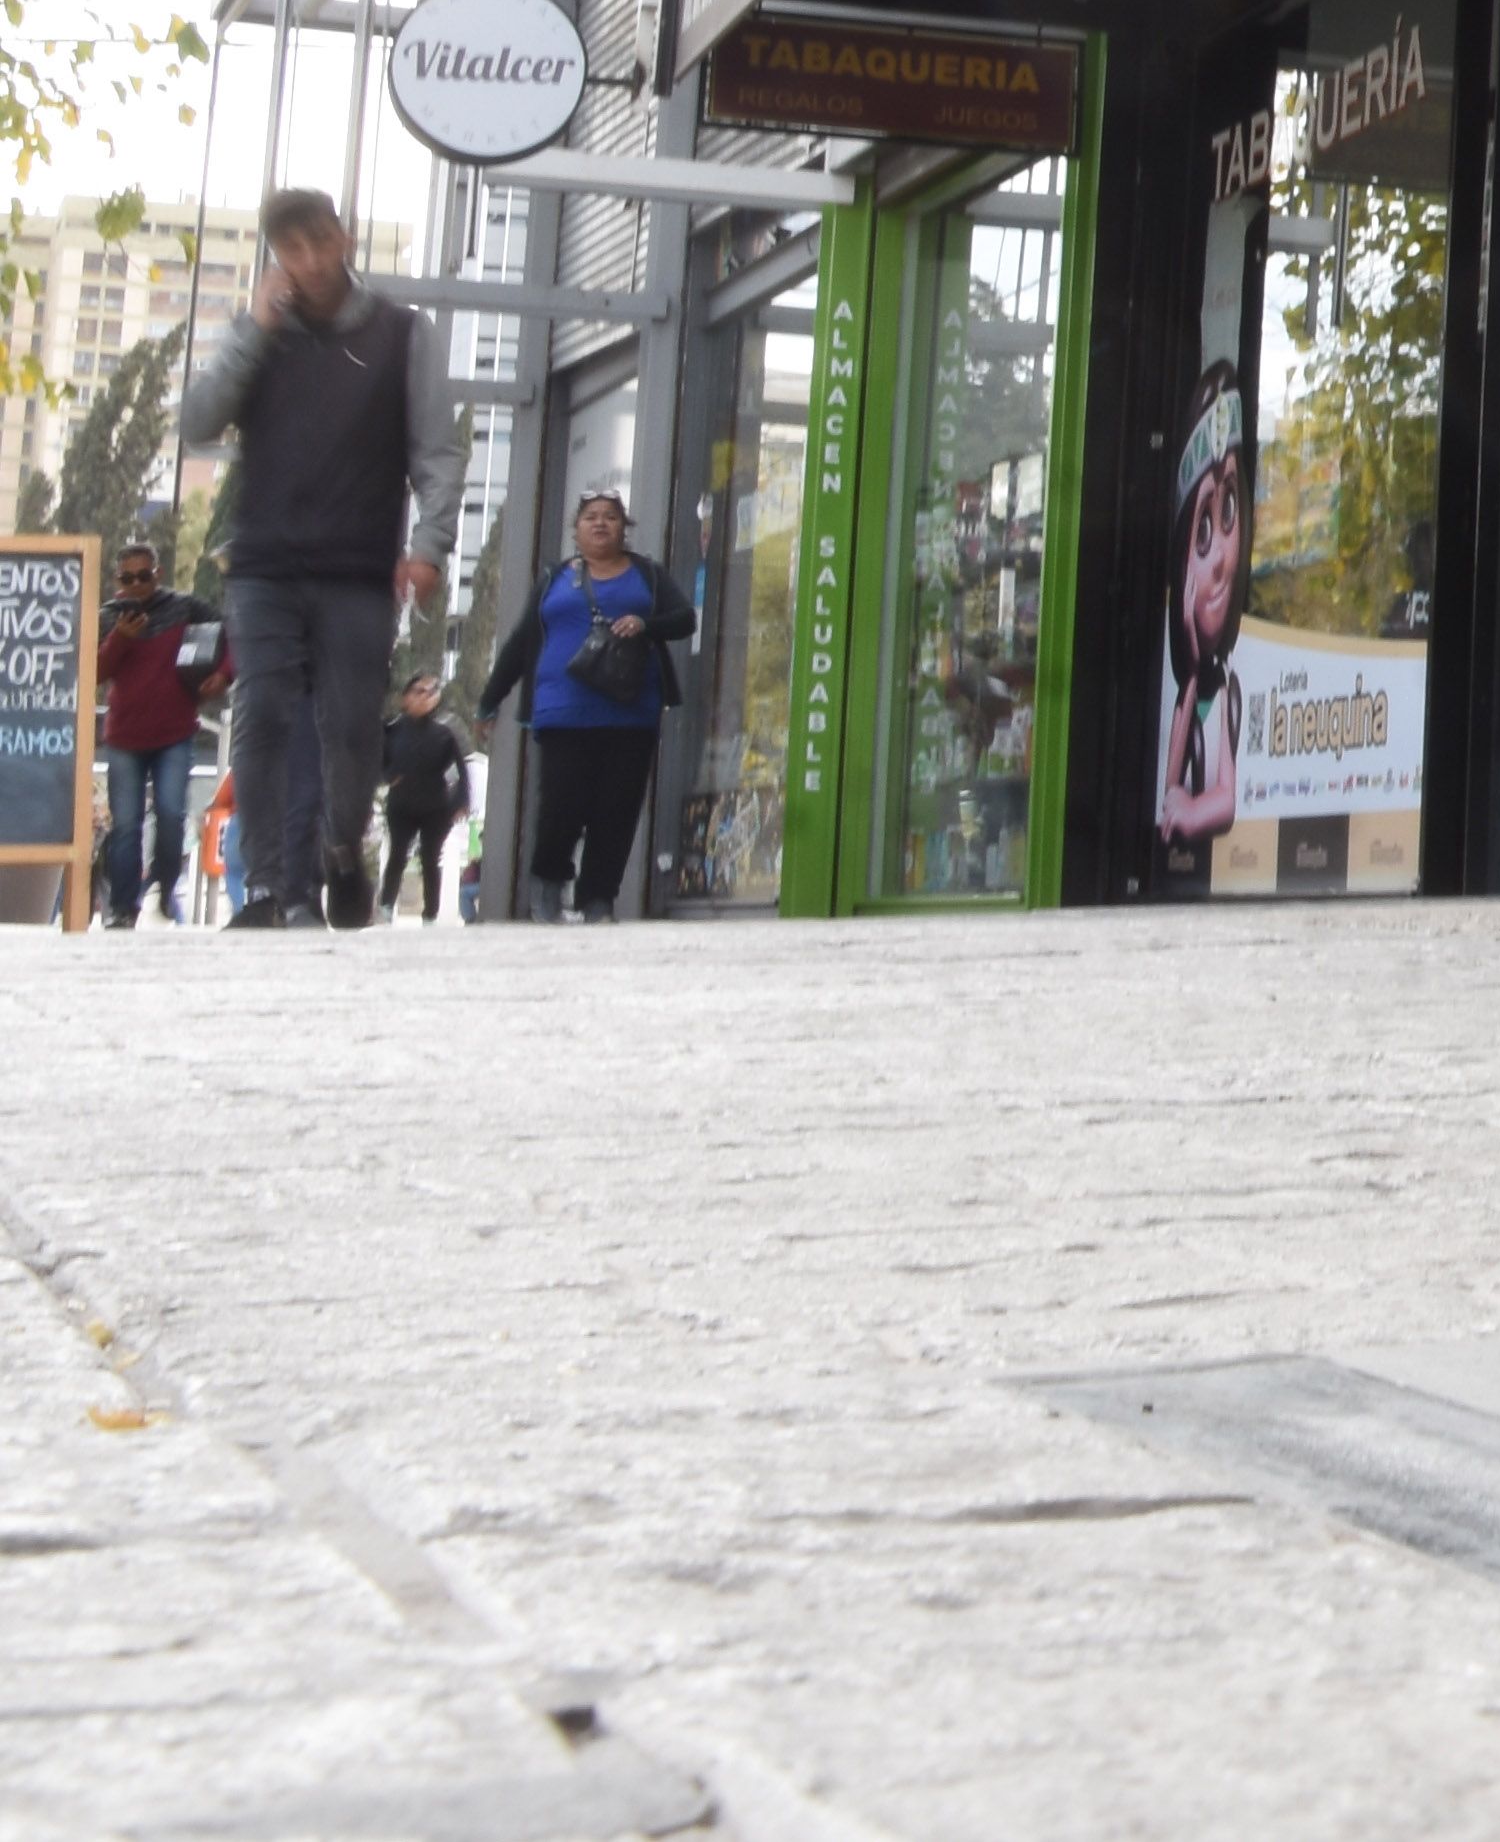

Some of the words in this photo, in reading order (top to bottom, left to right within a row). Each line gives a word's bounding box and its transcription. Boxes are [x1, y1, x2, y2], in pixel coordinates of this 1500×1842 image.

[403, 39, 576, 86] Vitalcer
[742, 34, 1039, 94] TABAQUERIA
[737, 86, 864, 116] REGALOS
[934, 104, 1038, 134] JUEGOS
[822, 298, 855, 496] ALMACEN
[8, 643, 74, 687] OFF
[803, 534, 839, 793] SALUDABLE
[11, 677, 78, 715] unidad
[1290, 672, 1389, 761] neuquina
